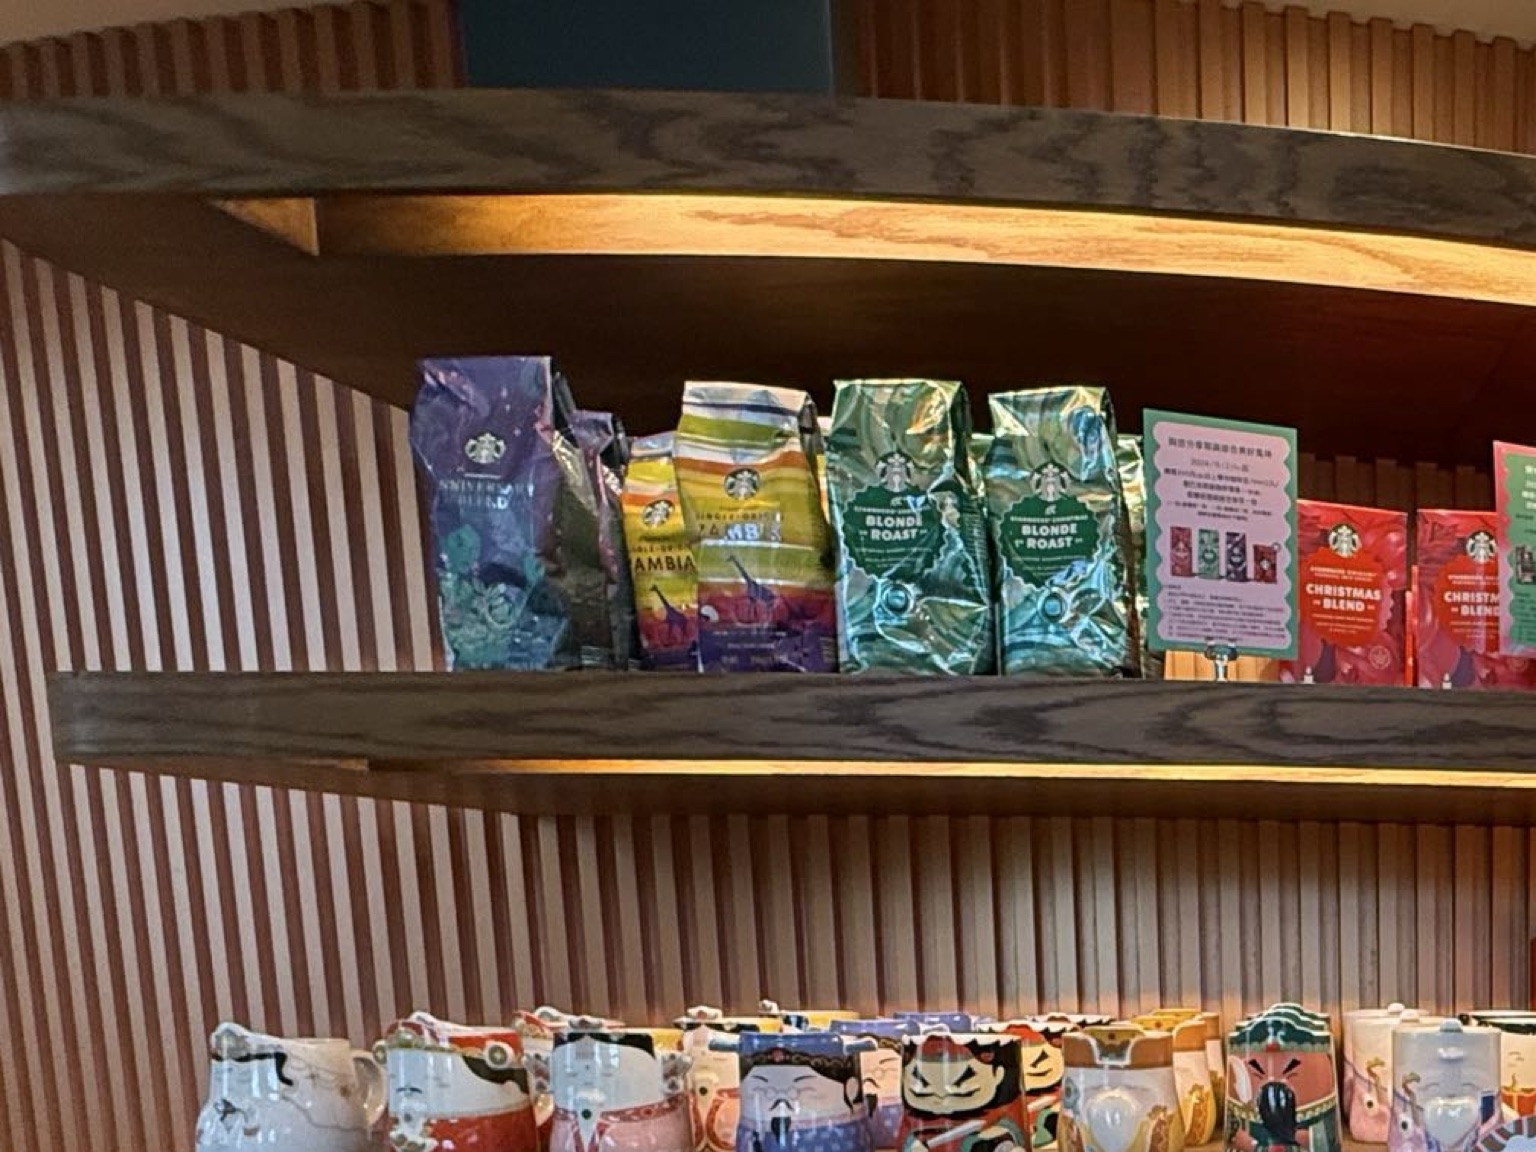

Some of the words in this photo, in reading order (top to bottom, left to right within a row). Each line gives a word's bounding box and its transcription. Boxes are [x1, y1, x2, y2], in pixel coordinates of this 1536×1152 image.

[870, 528, 918, 542] ROAST
[1021, 523, 1078, 537] BLONDE
[1026, 536, 1073, 549] ROAST
[633, 555, 696, 573] AMBIA
[1305, 583, 1382, 601] CHRISTMAS
[1444, 590, 1499, 604] CHRISTM
[1322, 598, 1366, 612] BLEND
